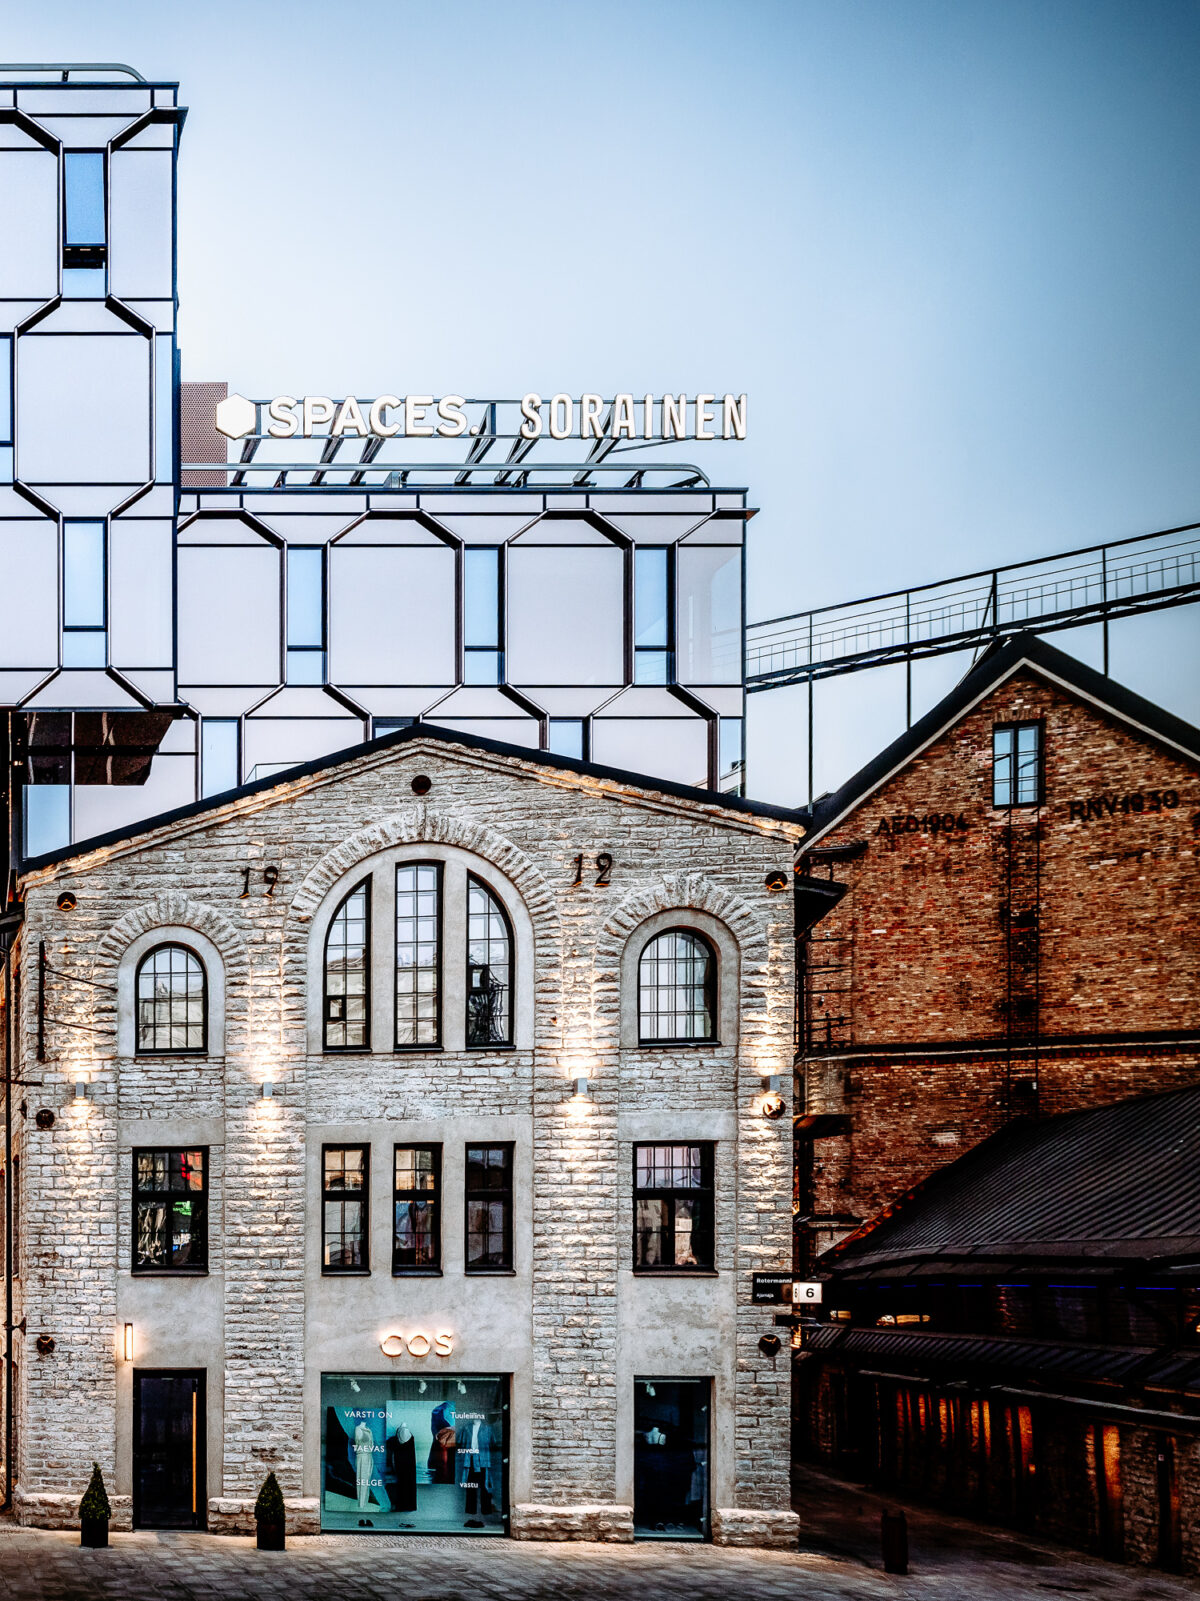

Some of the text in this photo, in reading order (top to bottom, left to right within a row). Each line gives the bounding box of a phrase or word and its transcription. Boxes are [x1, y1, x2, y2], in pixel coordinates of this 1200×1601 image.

[268, 394, 480, 438] SPACES.
[520, 392, 748, 440] SORAINEN
[805, 1287, 815, 1298] 6
[380, 1334, 453, 1358] COS
[344, 1410, 393, 1419] VARSTI ON
[352, 1444, 385, 1453] TAEVAS
[356, 1478, 383, 1487] SELGE
